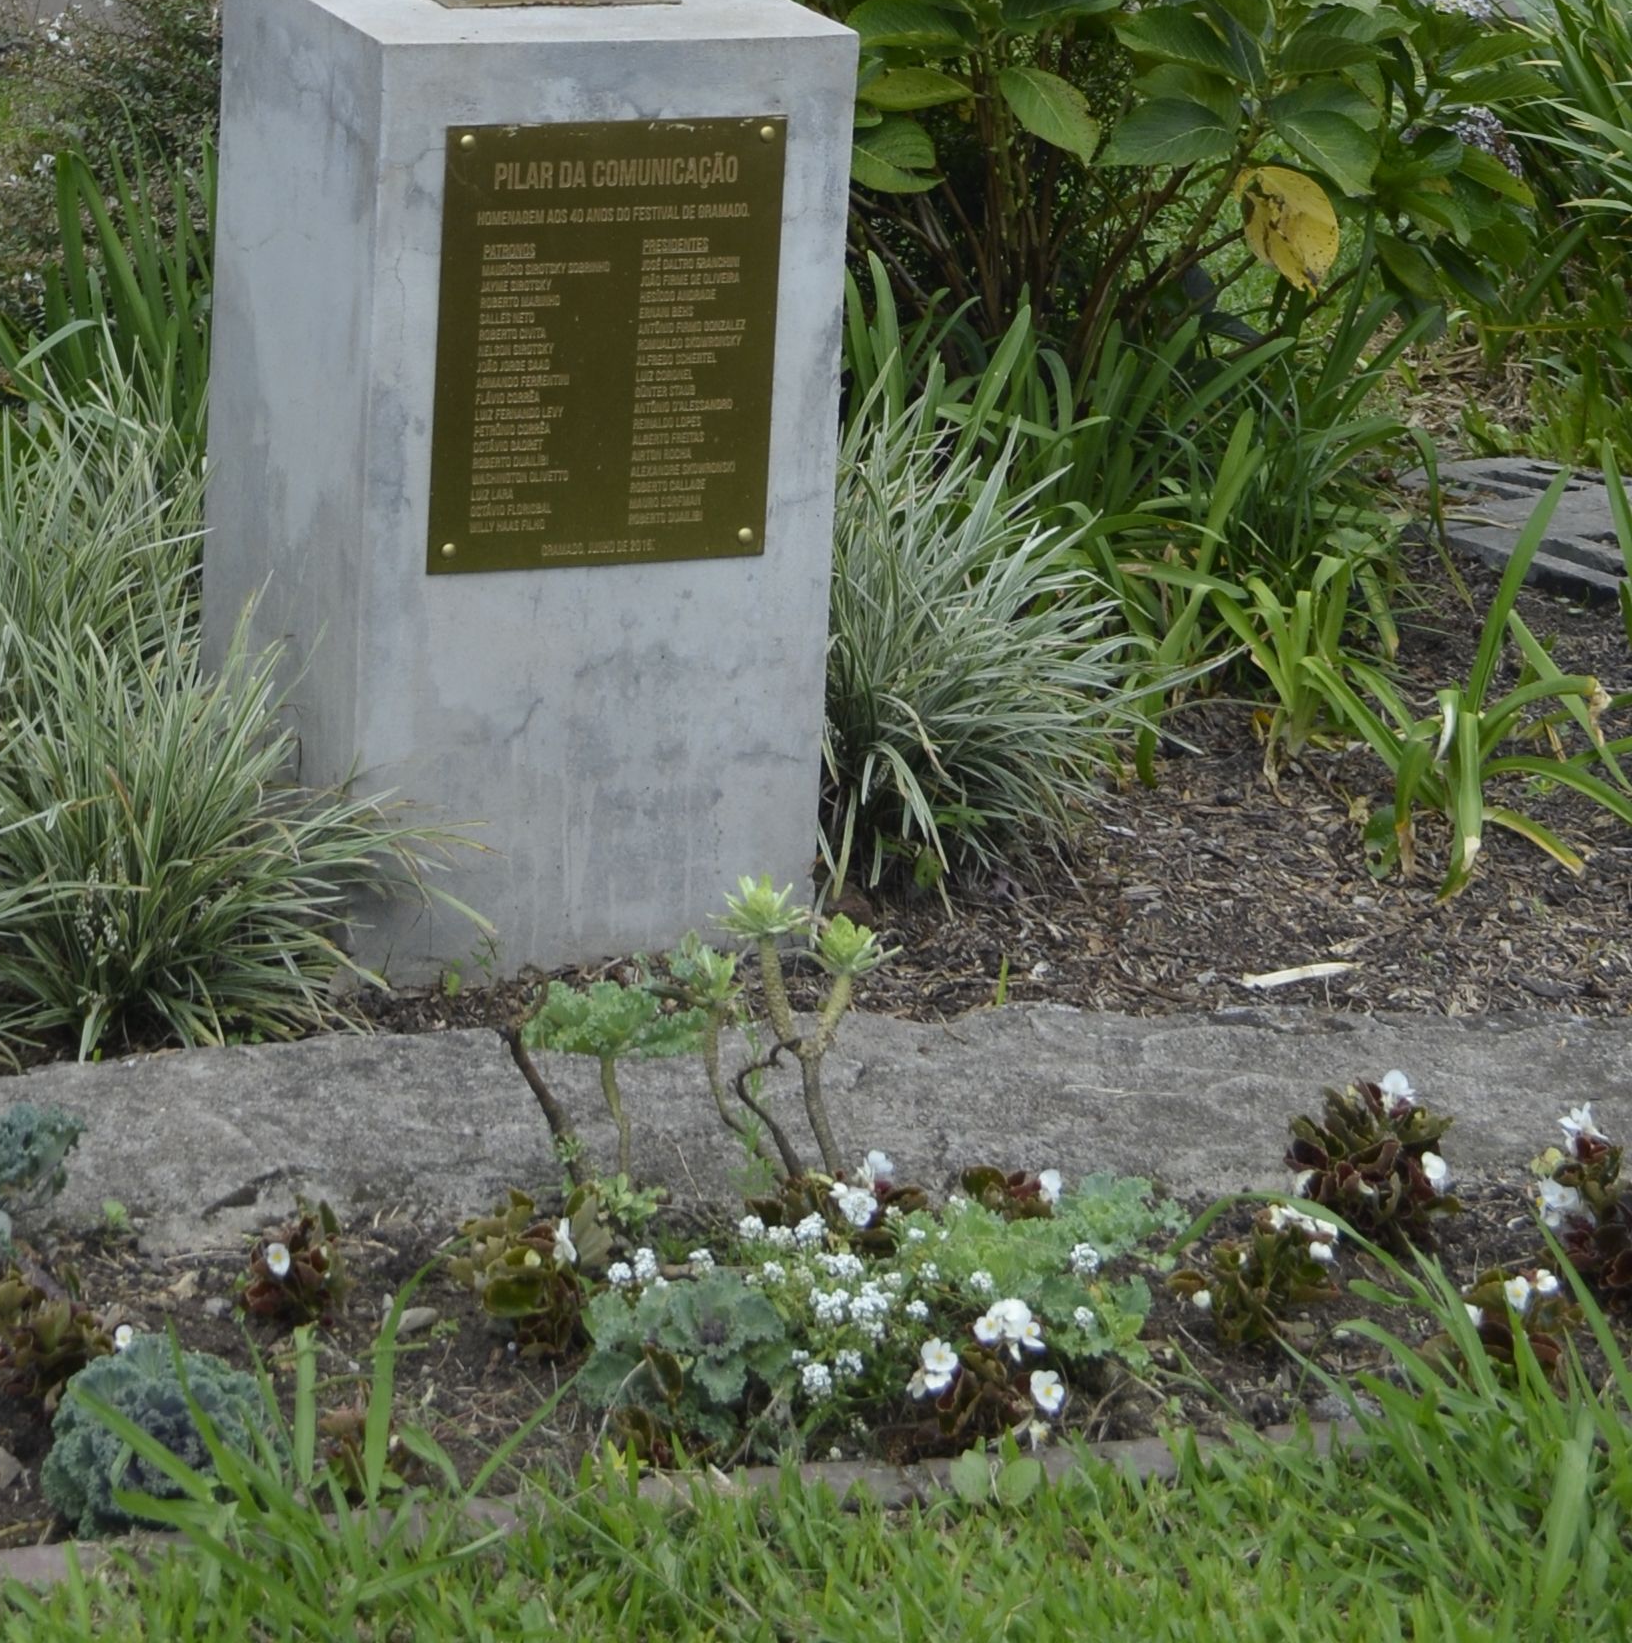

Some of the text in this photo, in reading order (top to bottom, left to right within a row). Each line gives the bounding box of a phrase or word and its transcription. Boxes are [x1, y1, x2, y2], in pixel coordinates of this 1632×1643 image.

[494, 152, 738, 190] PILAR DA COMUNICAÇÃO
[476, 203, 750, 226] HOMENAGEM AOS 40 ANOS DO FESTIVAL DE GRAMADO.
[484, 243, 536, 260] PATRONOS
[642, 237, 709, 255] PRESIDENTES
[690, 273, 701, 285] DE
[703, 272, 740, 284] OLIVEIRA
[480, 296, 519, 308] ROBERTO
[512, 311, 535, 324] NETO
[479, 328, 517, 341] ROBERTO
[635, 370, 654, 382] LUIZ
[474, 406, 564, 421] LUIZ FERNANDO LEVY
[675, 416, 702, 428] LOPES
[632, 433, 669, 445] ALBERTO
[472, 456, 511, 469] ROBERTO
[630, 480, 667, 493] ROBERTO
[470, 487, 514, 501] LUIZ LARA
[617, 540, 627, 552] DE
